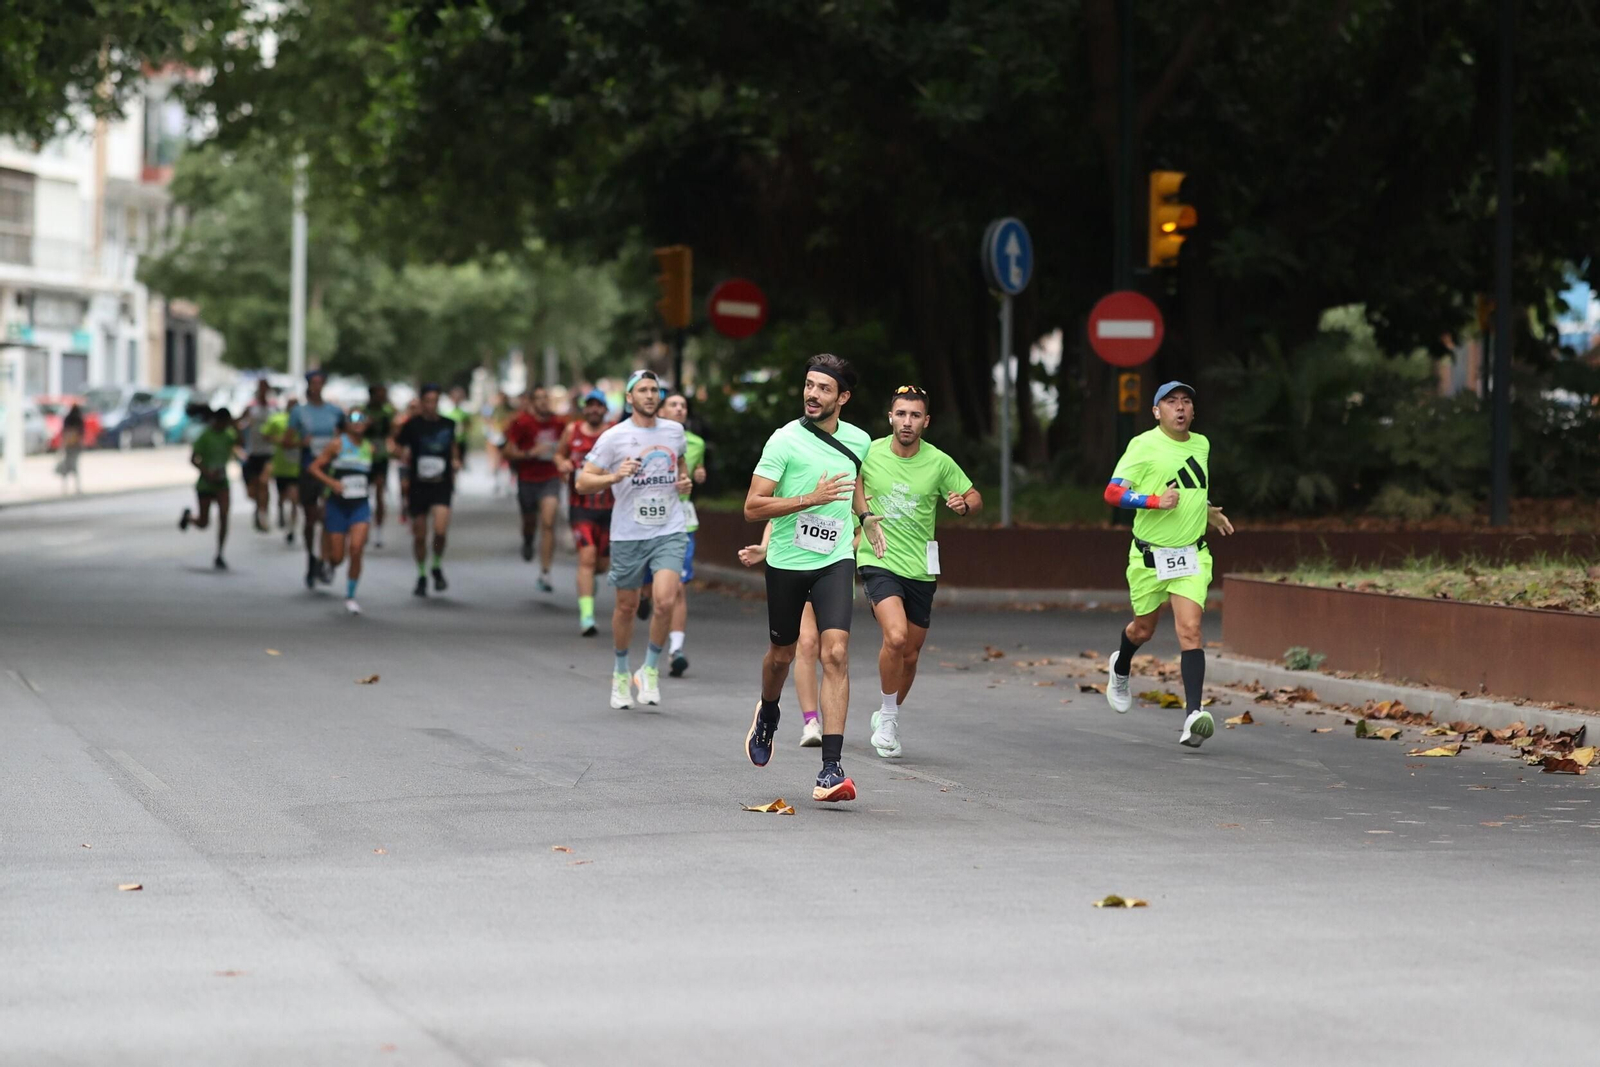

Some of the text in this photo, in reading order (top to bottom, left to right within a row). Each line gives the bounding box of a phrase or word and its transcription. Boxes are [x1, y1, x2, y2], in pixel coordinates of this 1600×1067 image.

[640, 506, 666, 516] 699
[800, 524, 837, 541] 1092
[1166, 555, 1187, 569] 54
